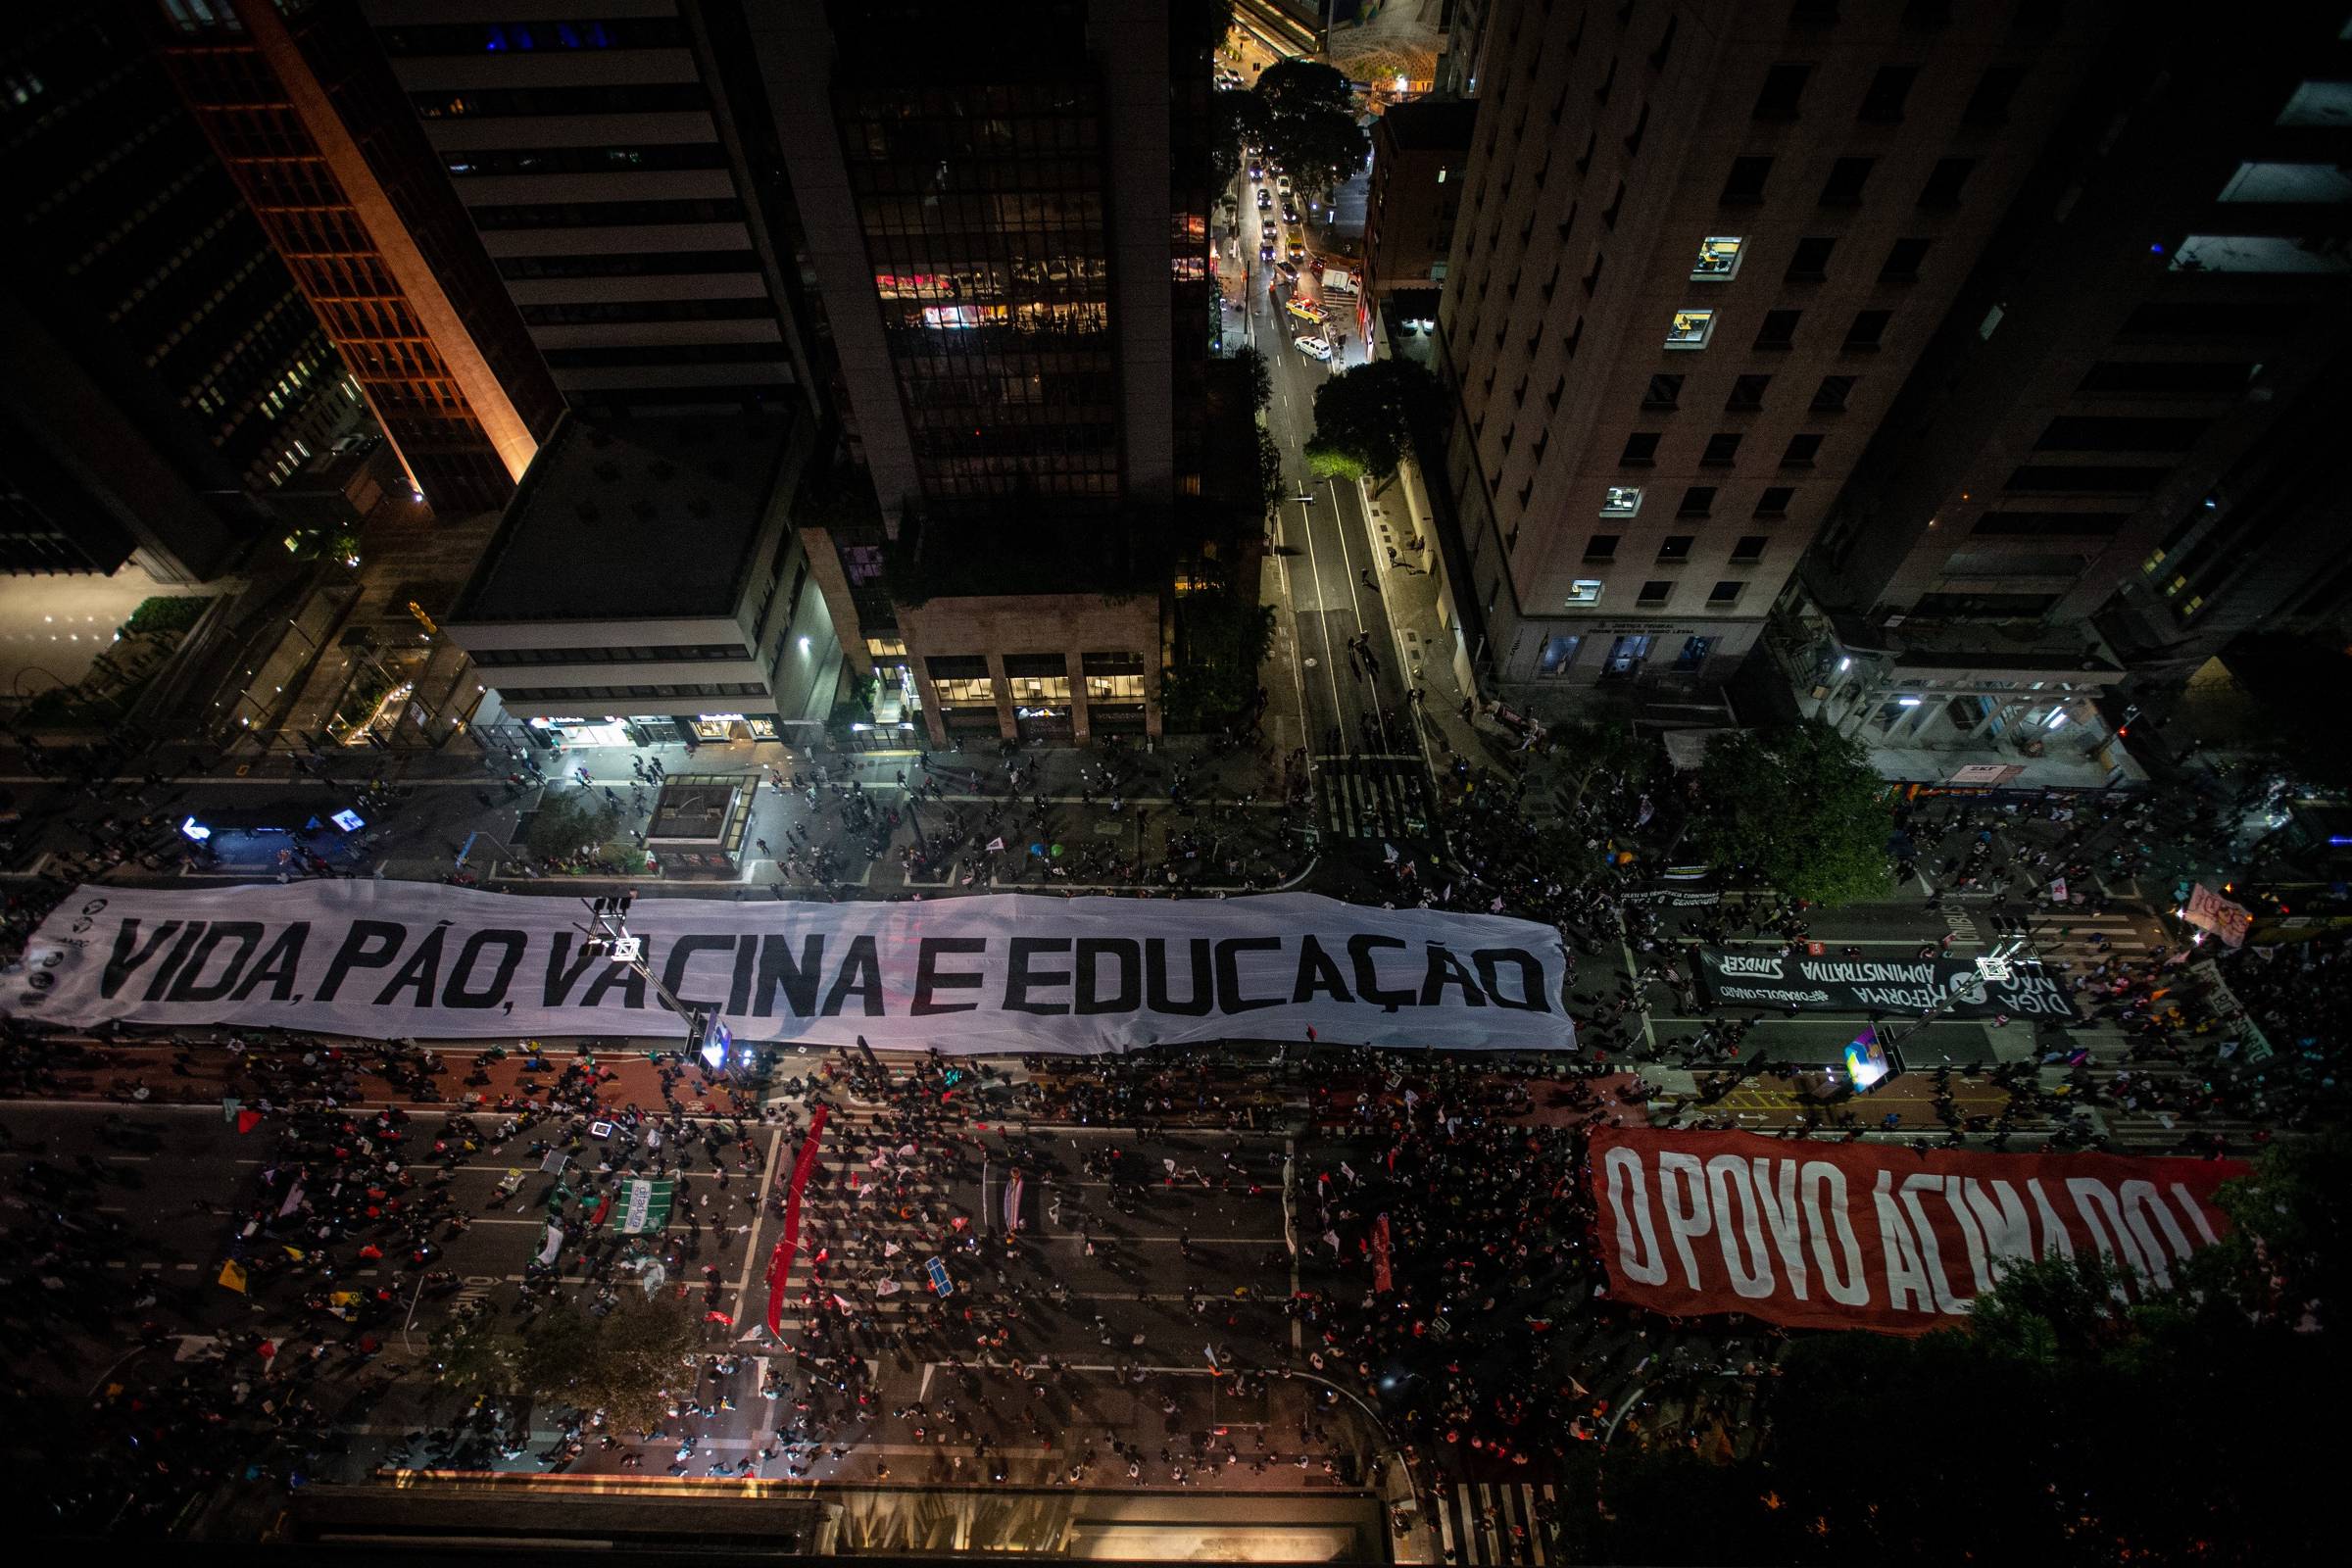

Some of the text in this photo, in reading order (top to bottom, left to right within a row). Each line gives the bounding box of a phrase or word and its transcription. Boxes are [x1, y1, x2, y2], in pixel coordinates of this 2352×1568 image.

[101, 918, 1551, 1018] VIDA, PÃO, VACINA E EDUCAÇÃO
[1720, 956, 1785, 980] SINDSEP
[1799, 961, 1936, 985] ADMINISTRATIVA
[1720, 986, 1830, 1003] #FORABOLSONARO
[1850, 984, 1955, 1011] REFORMA
[1997, 993, 2073, 1016] DIGA
[1603, 1147, 1668, 1287] O
[1658, 1151, 1871, 1306] POVO
